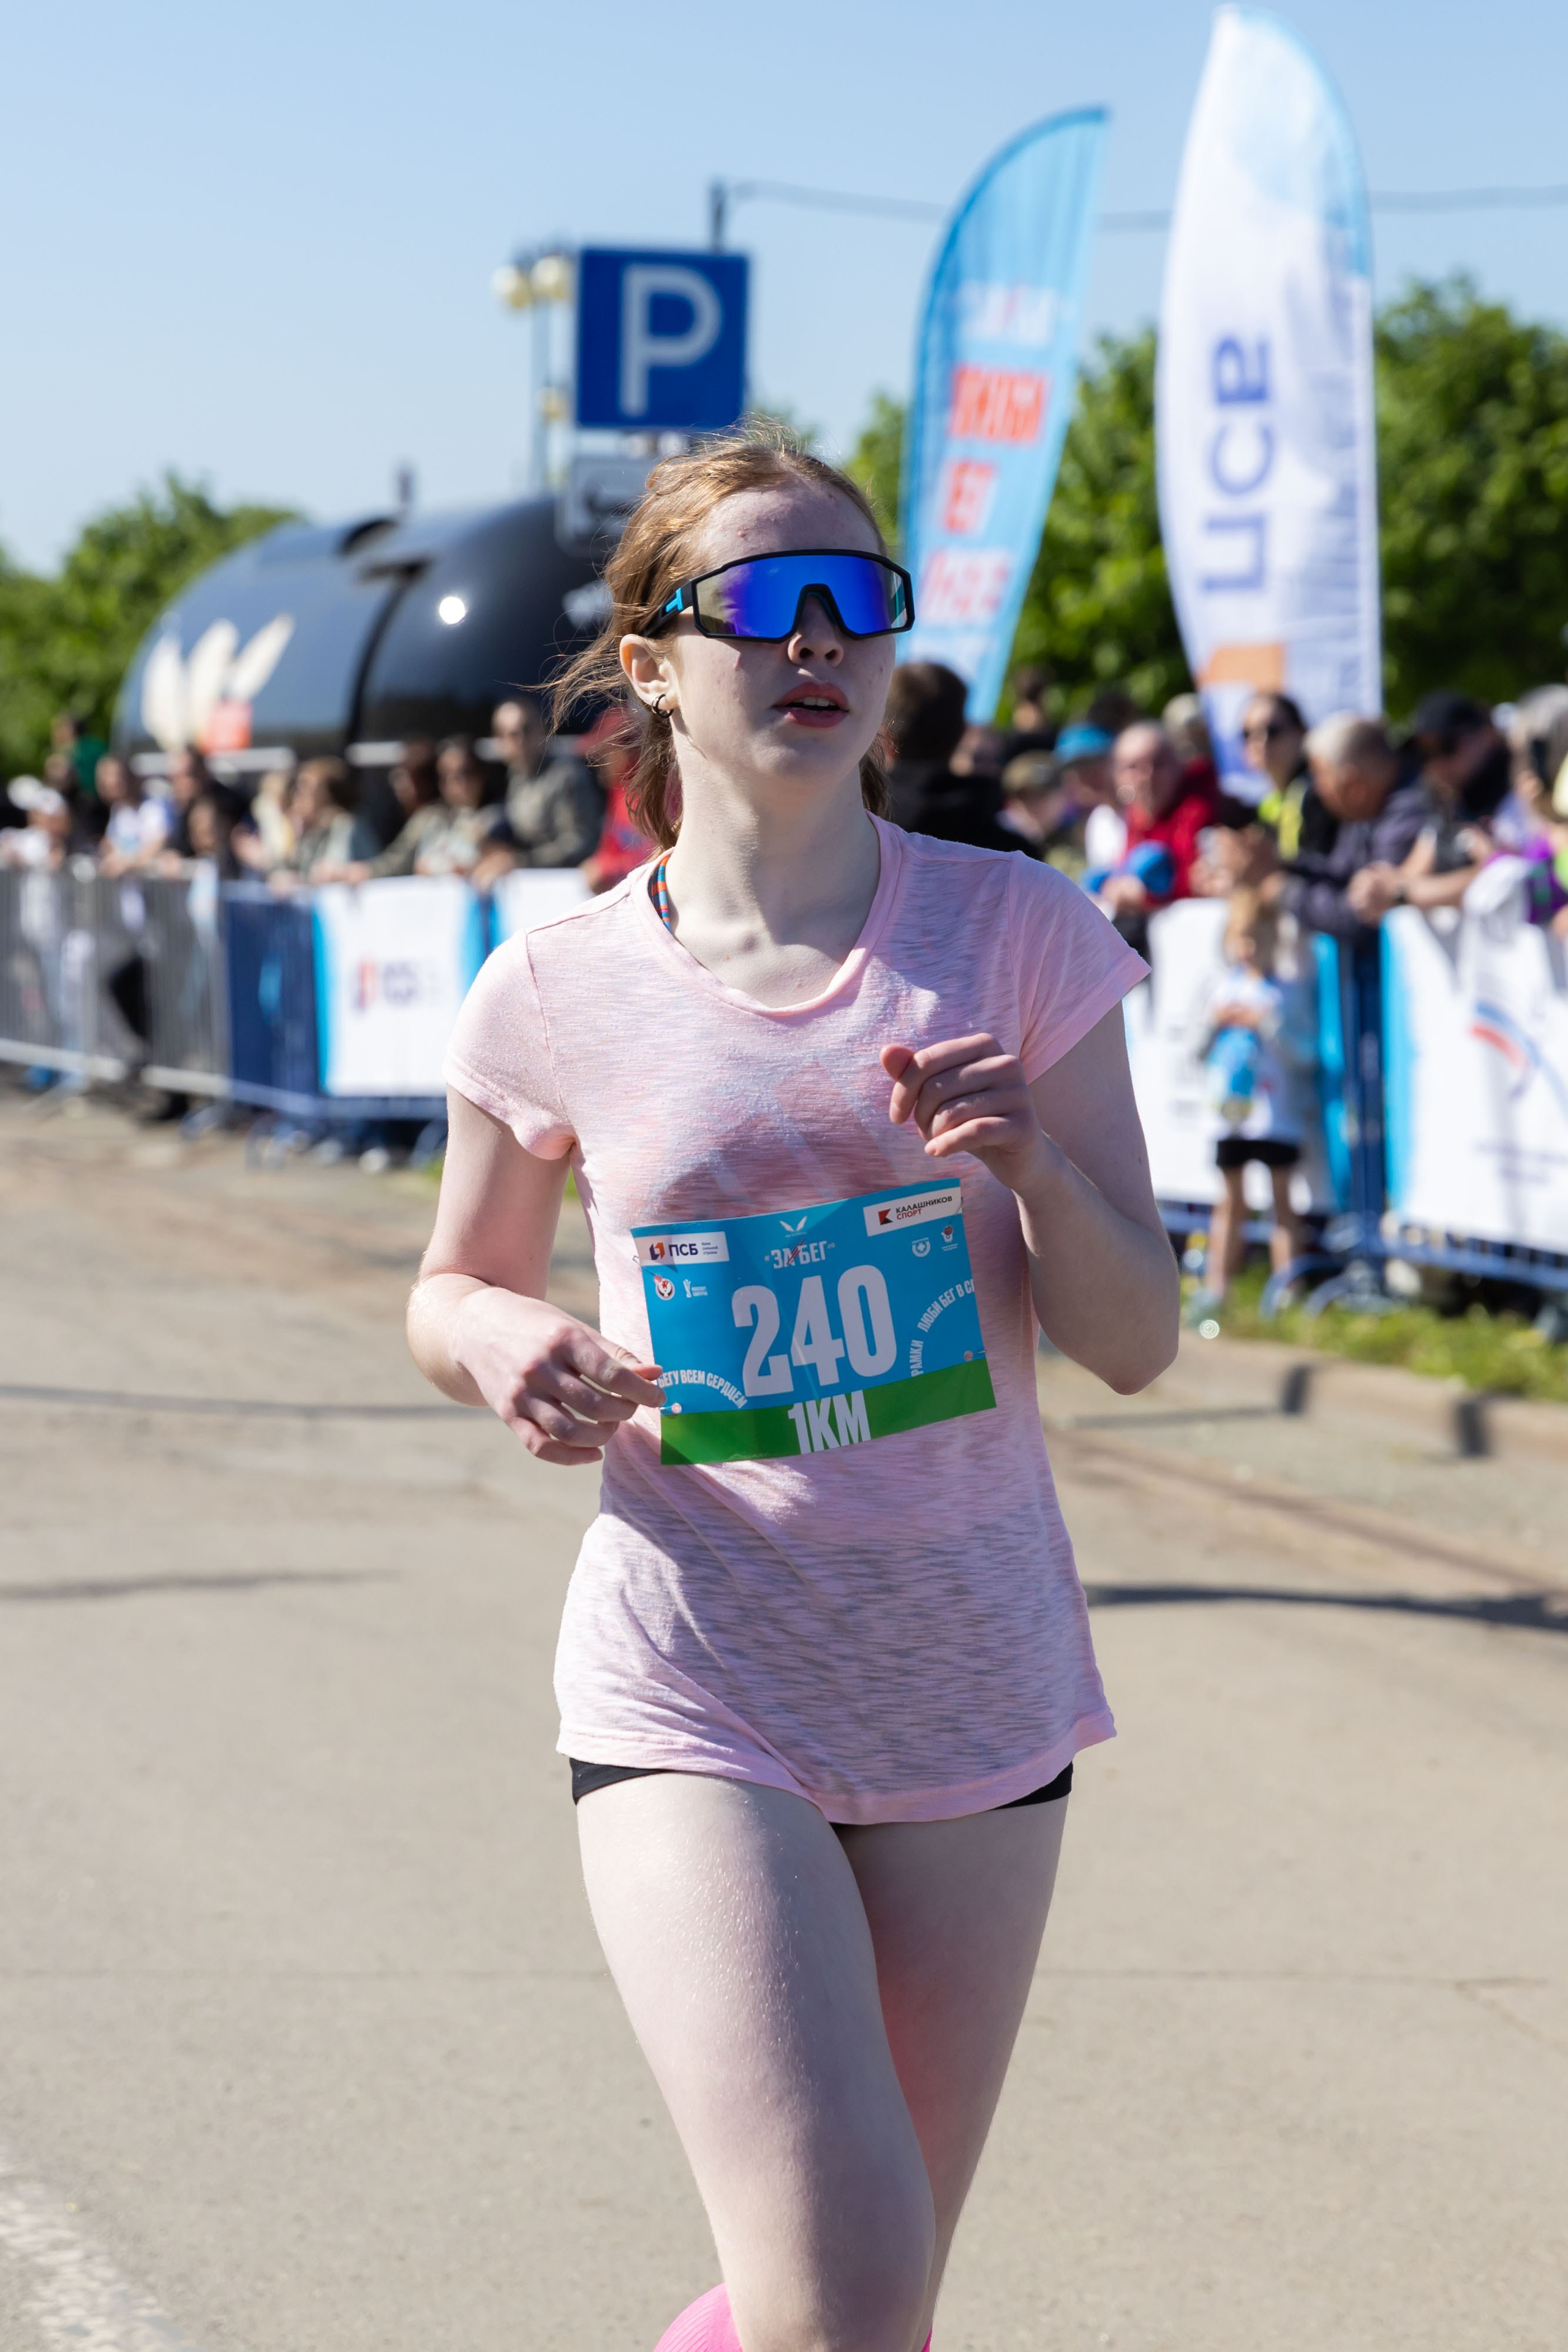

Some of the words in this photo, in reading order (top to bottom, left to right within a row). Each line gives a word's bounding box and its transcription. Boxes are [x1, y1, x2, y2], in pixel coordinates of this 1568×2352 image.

[620, 263, 724, 417] P
[895, 1196, 952, 1213] КАЛАШНИКОВ
[897, 1208, 922, 1220] СПОРТ
[669, 1243, 698, 1257] ПСБ
[917, 1300, 944, 1333] ЛЮБИ
[938, 1287, 956, 1308] БЕГ
[956, 1284, 965, 1298] В
[731, 1265, 897, 1397] 240
[910, 1340, 924, 1377] РАМКИ
[657, 1370, 679, 1388] БЕГУ
[680, 1369, 706, 1385] ВСЕМ
[706, 1373, 748, 1409] СЕРДЦЕМ
